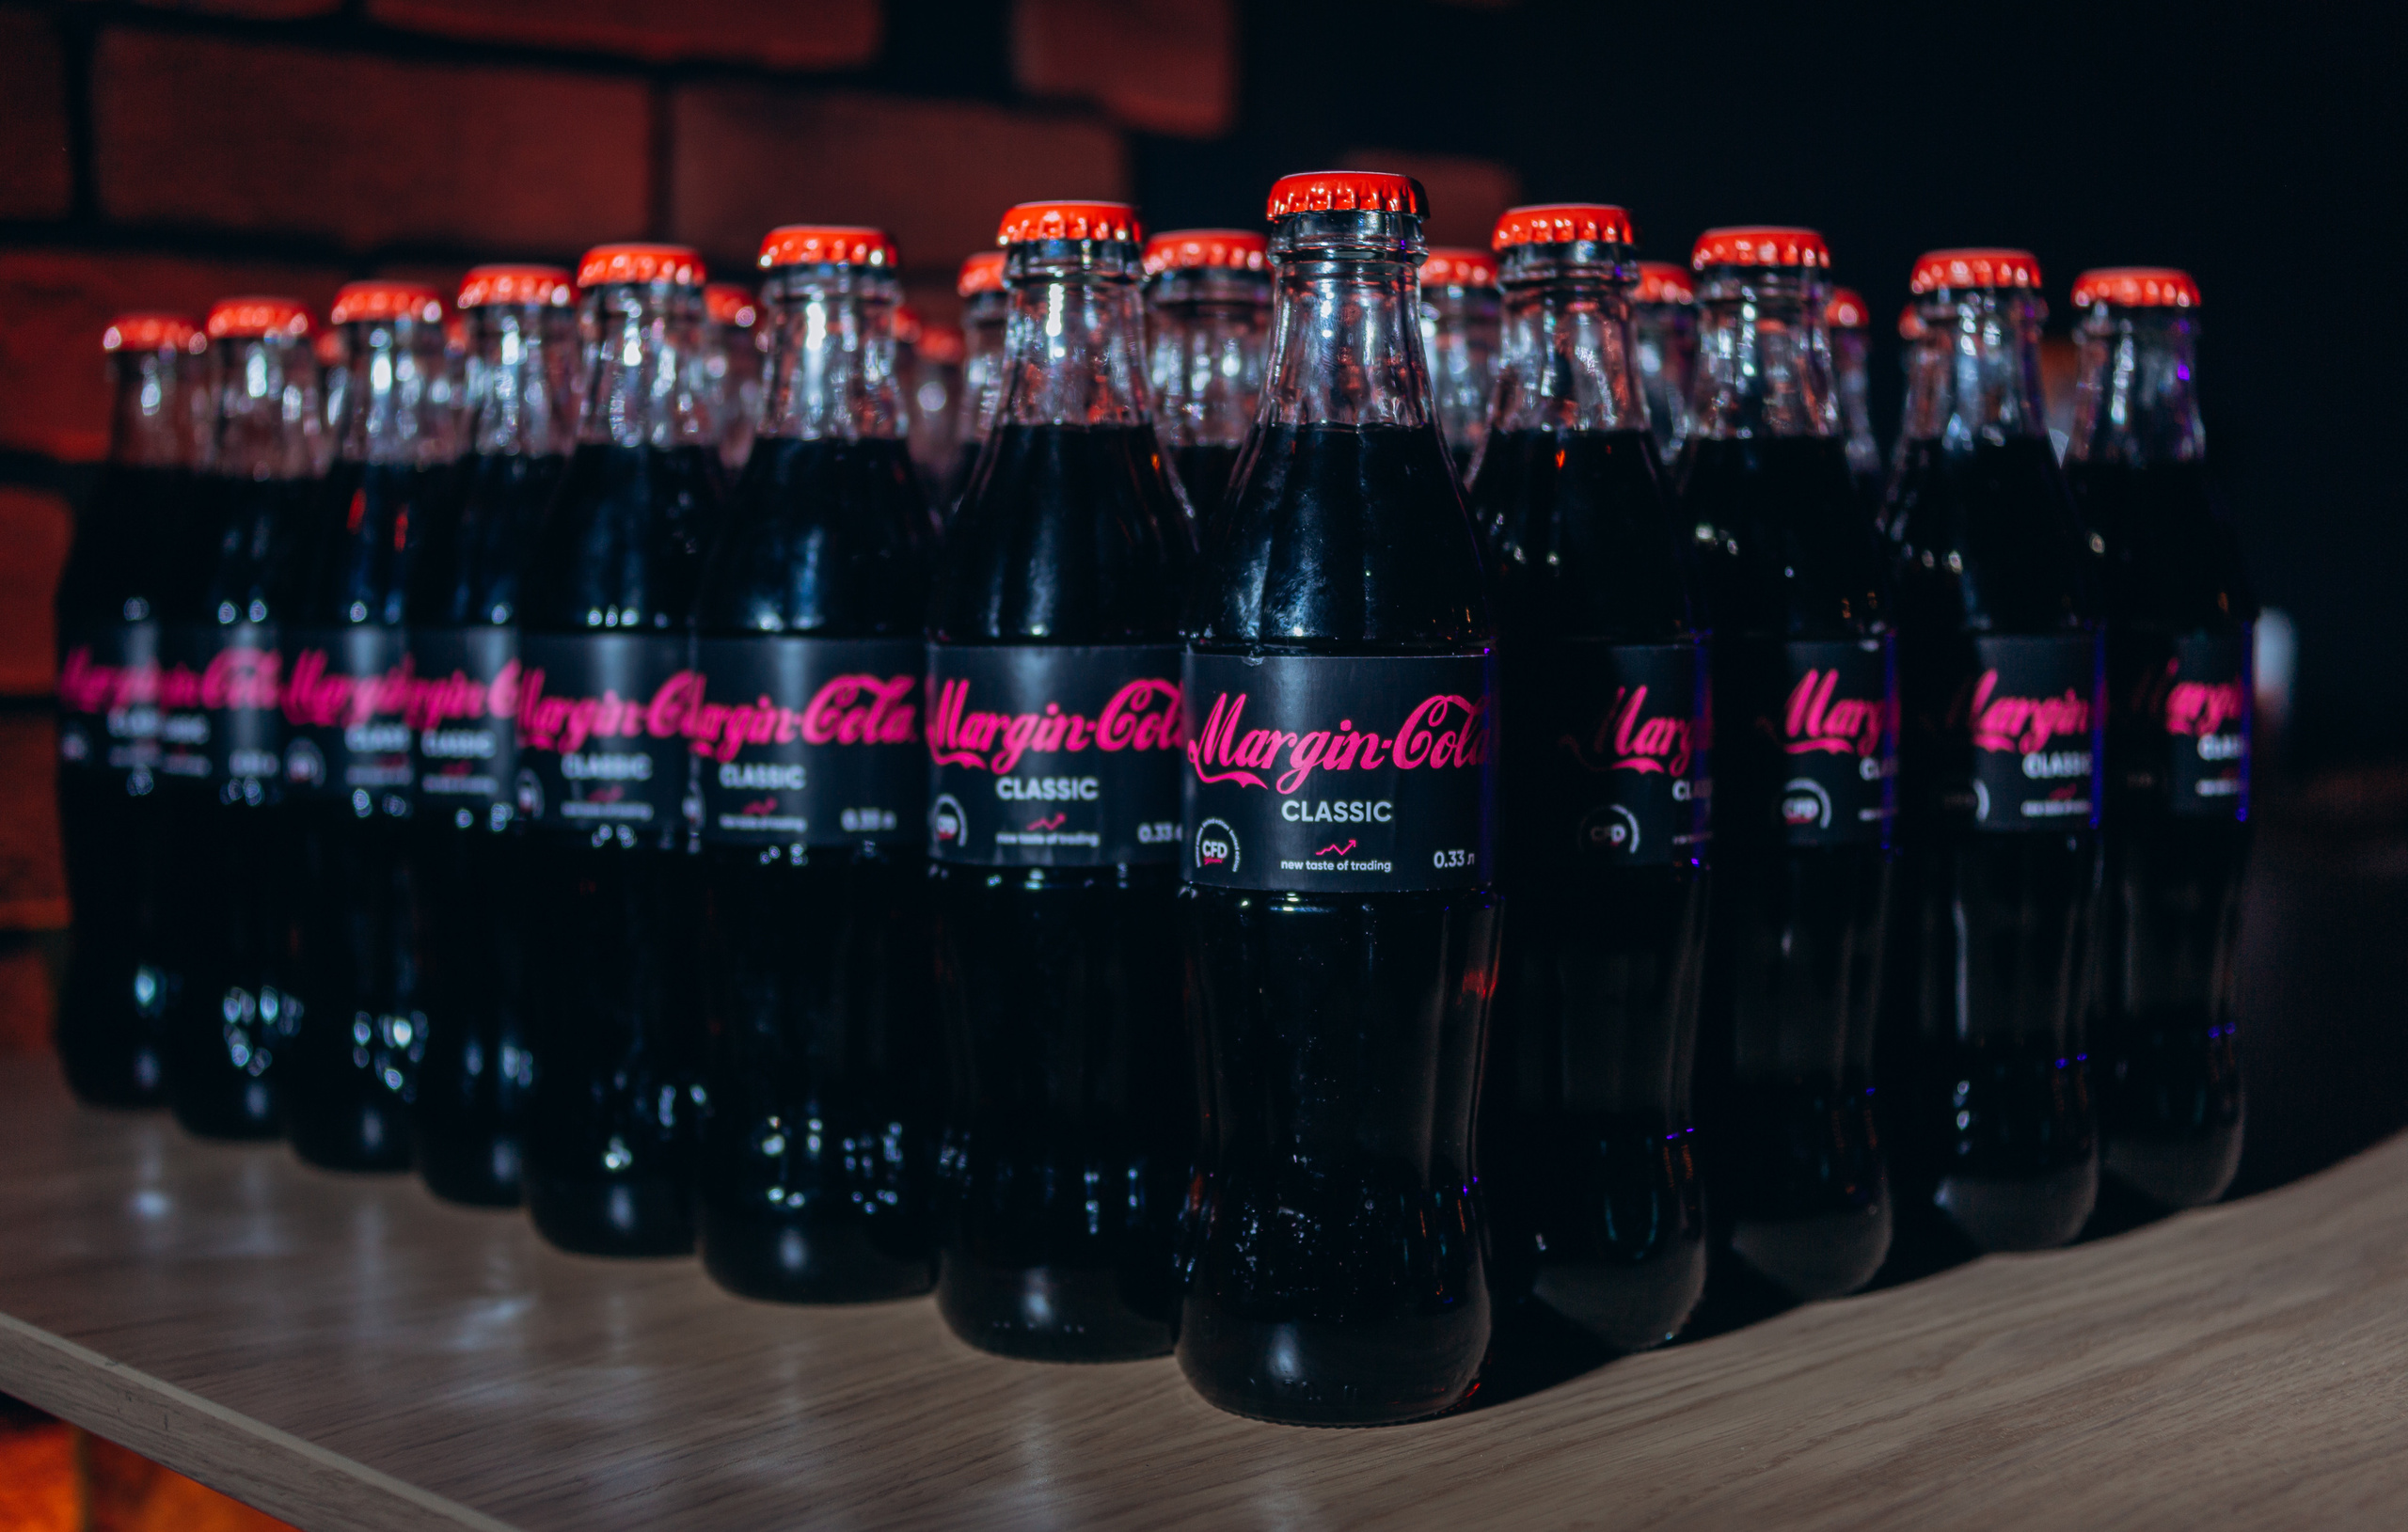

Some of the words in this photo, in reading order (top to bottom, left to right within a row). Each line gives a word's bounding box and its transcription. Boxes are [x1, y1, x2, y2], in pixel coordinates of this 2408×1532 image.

[995, 776, 1100, 801] CLASSIC
[1281, 800, 1392, 823] CLASSIC
[1202, 839, 1228, 859] CFD
[1433, 848, 1465, 869] 0.33
[1280, 860, 1304, 871] new
[1305, 860, 1335, 871] taste
[1336, 859, 1349, 871] of
[1350, 860, 1392, 874] trading
